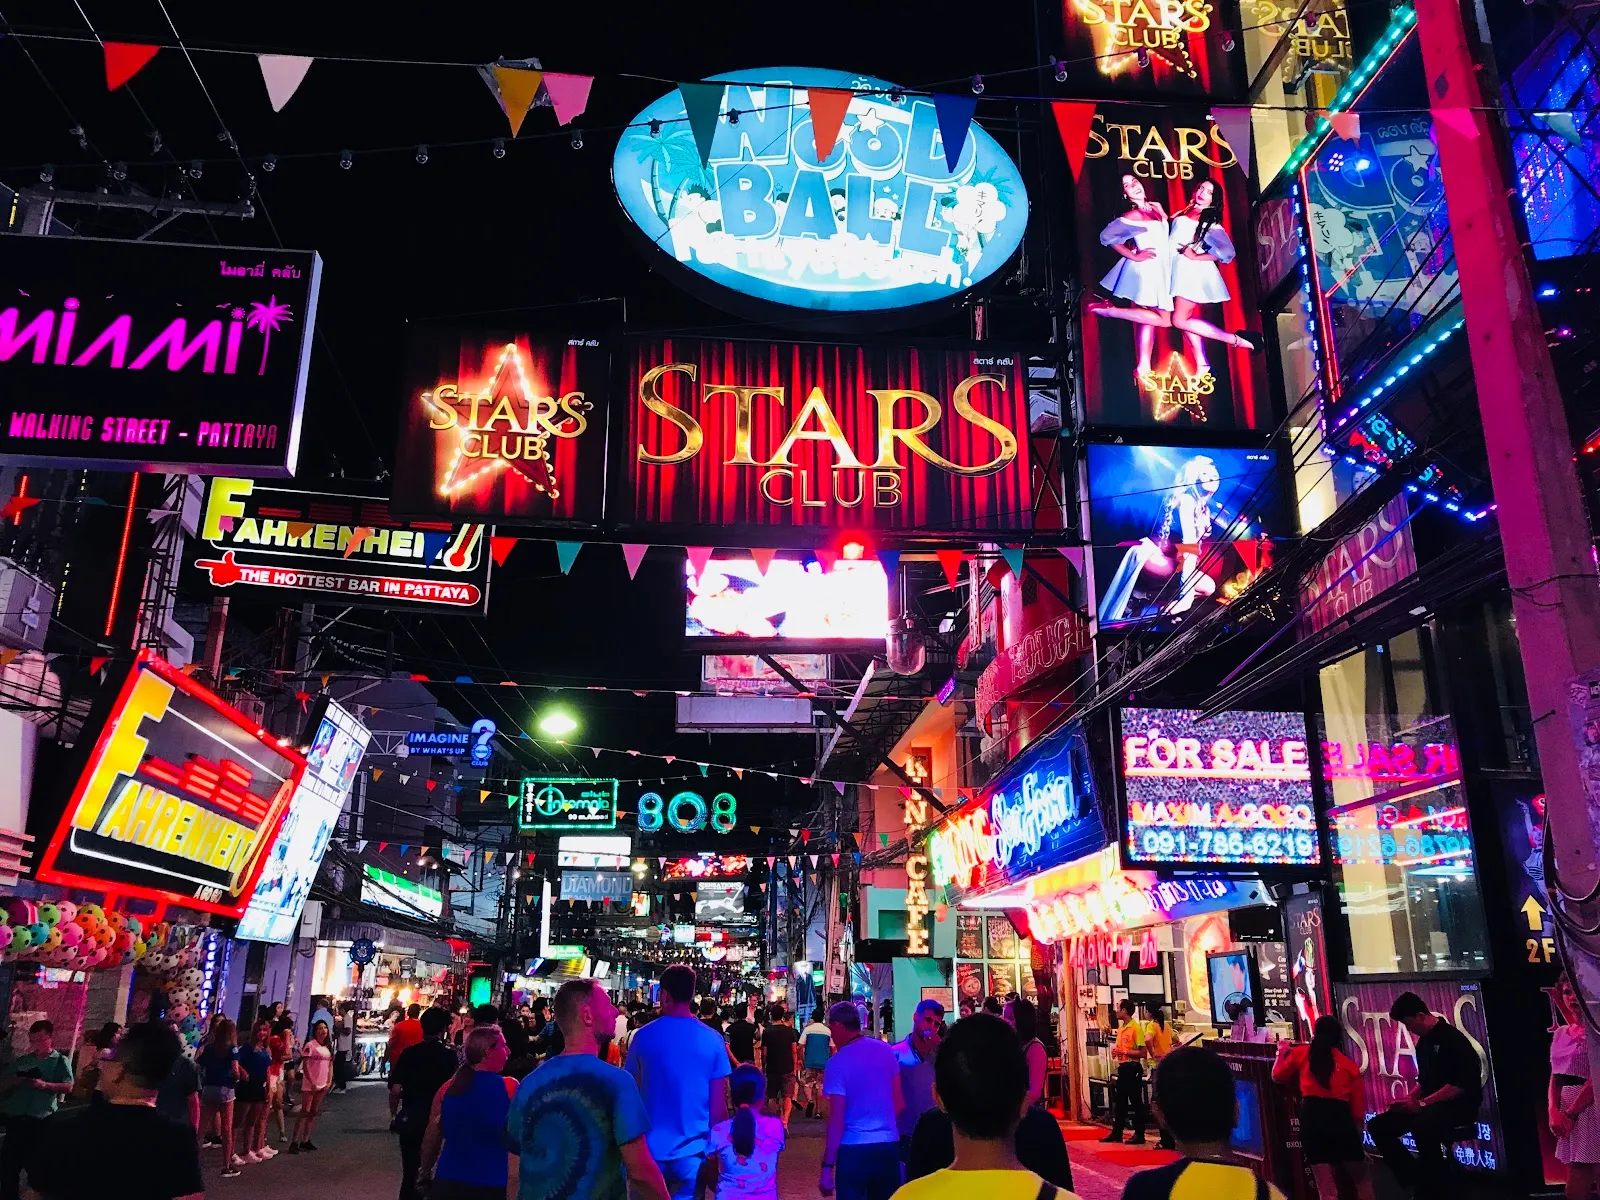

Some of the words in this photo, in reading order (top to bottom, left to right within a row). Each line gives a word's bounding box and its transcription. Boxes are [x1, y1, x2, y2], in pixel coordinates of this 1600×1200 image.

[1083, 0, 1211, 32] STARS
[1112, 27, 1178, 48] CLUB
[1084, 114, 1239, 169] STARS
[1132, 160, 1195, 181] CLUB
[714, 162, 954, 259] BALL
[1144, 370, 1216, 395] STARS
[1159, 391, 1197, 405] CLUB
[429, 384, 588, 438] STARS
[637, 362, 1018, 477] STARS
[9, 412, 94, 441] WALKING
[101, 417, 171, 444] STREET
[197, 421, 278, 449] PATTAYA
[459, 433, 544, 461] CLUB
[758, 468, 903, 508] CLUB
[239, 568, 269, 584] THE
[272, 571, 345, 590] HOTTEST
[347, 579, 381, 594] BAR
[383, 581, 400, 594] IN
[403, 584, 470, 601] PATTAYA
[409, 732, 469, 744] IMAGINE
[422, 747, 454, 755] WHAT'S
[1123, 738, 1202, 770] FOR
[1210, 738, 1310, 771] SALE
[637, 791, 737, 834] 808
[562, 874, 634, 894] DIAMOND
[1526, 937, 1556, 963] 2F
[1340, 993, 1489, 1090] STAS
[1455, 1146, 1496, 1171] 免费入场
